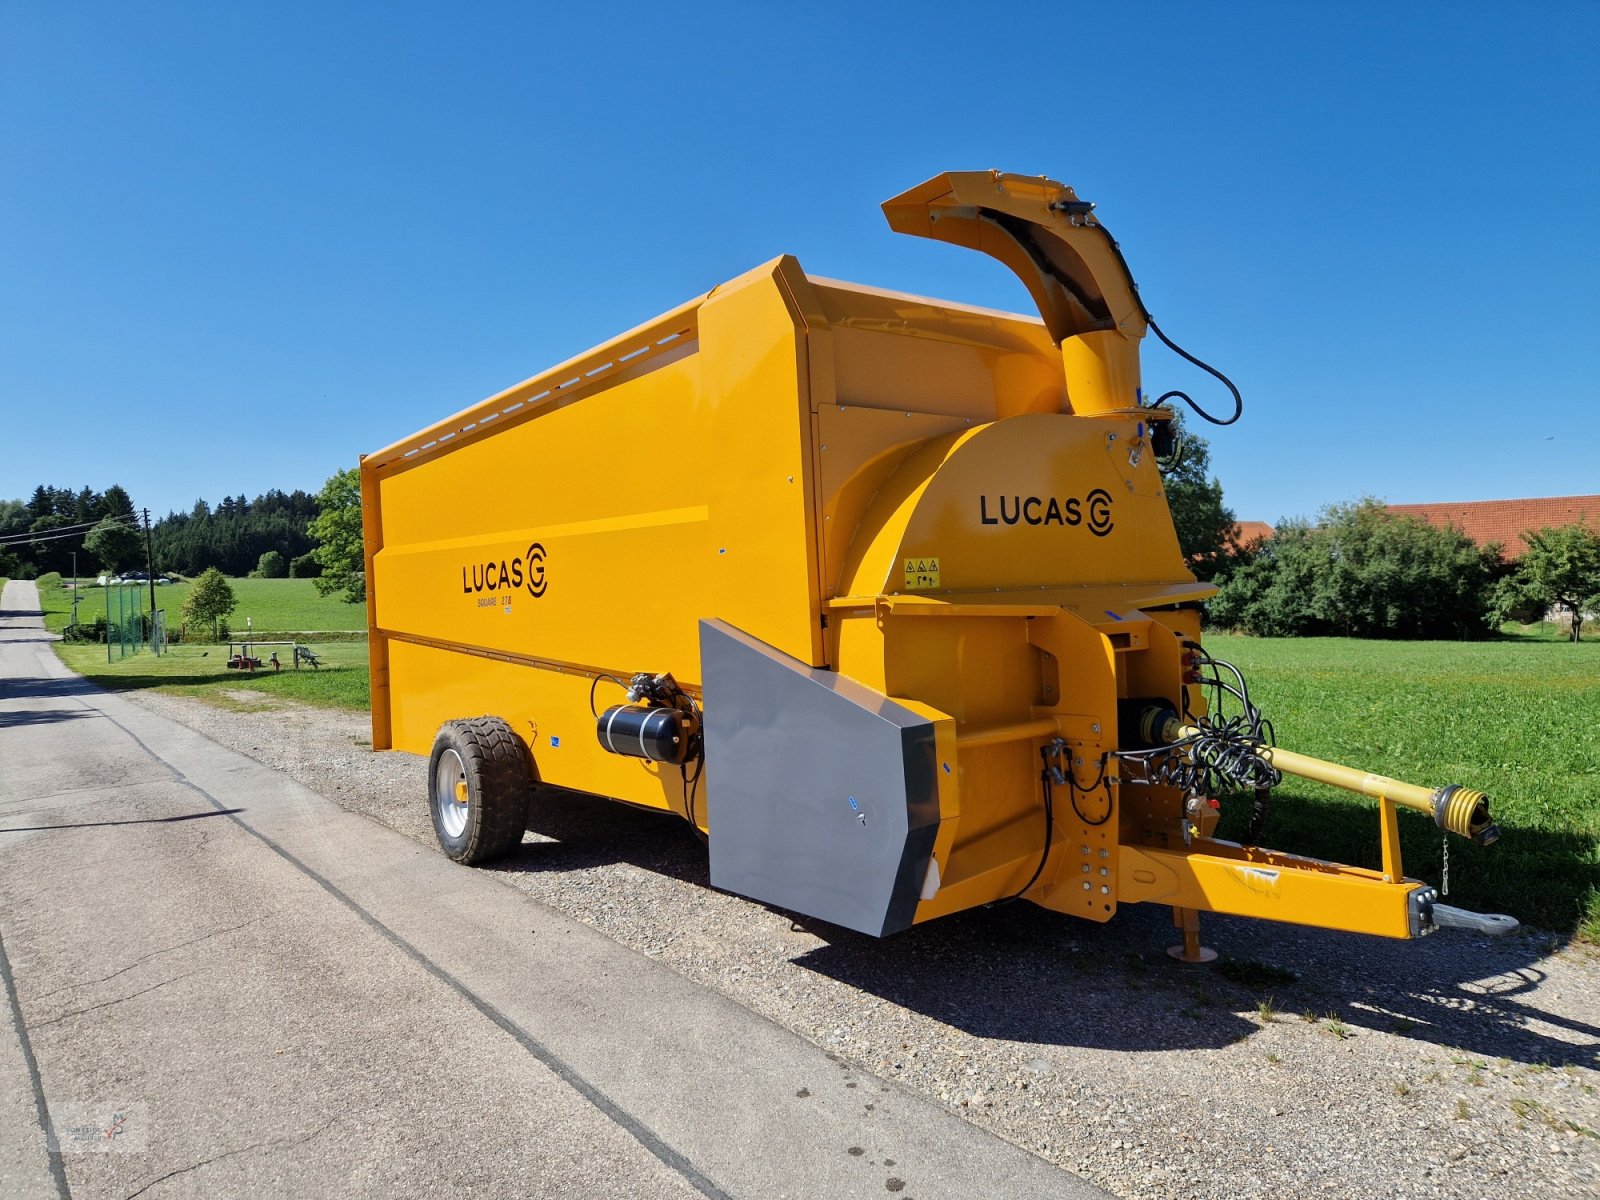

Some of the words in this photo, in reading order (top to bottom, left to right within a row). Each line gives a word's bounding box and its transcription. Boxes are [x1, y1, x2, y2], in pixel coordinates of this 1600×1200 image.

[980, 495, 1082, 526] LUCAS
[463, 557, 523, 594] LUCAS
[477, 596, 497, 608] SQUARE
